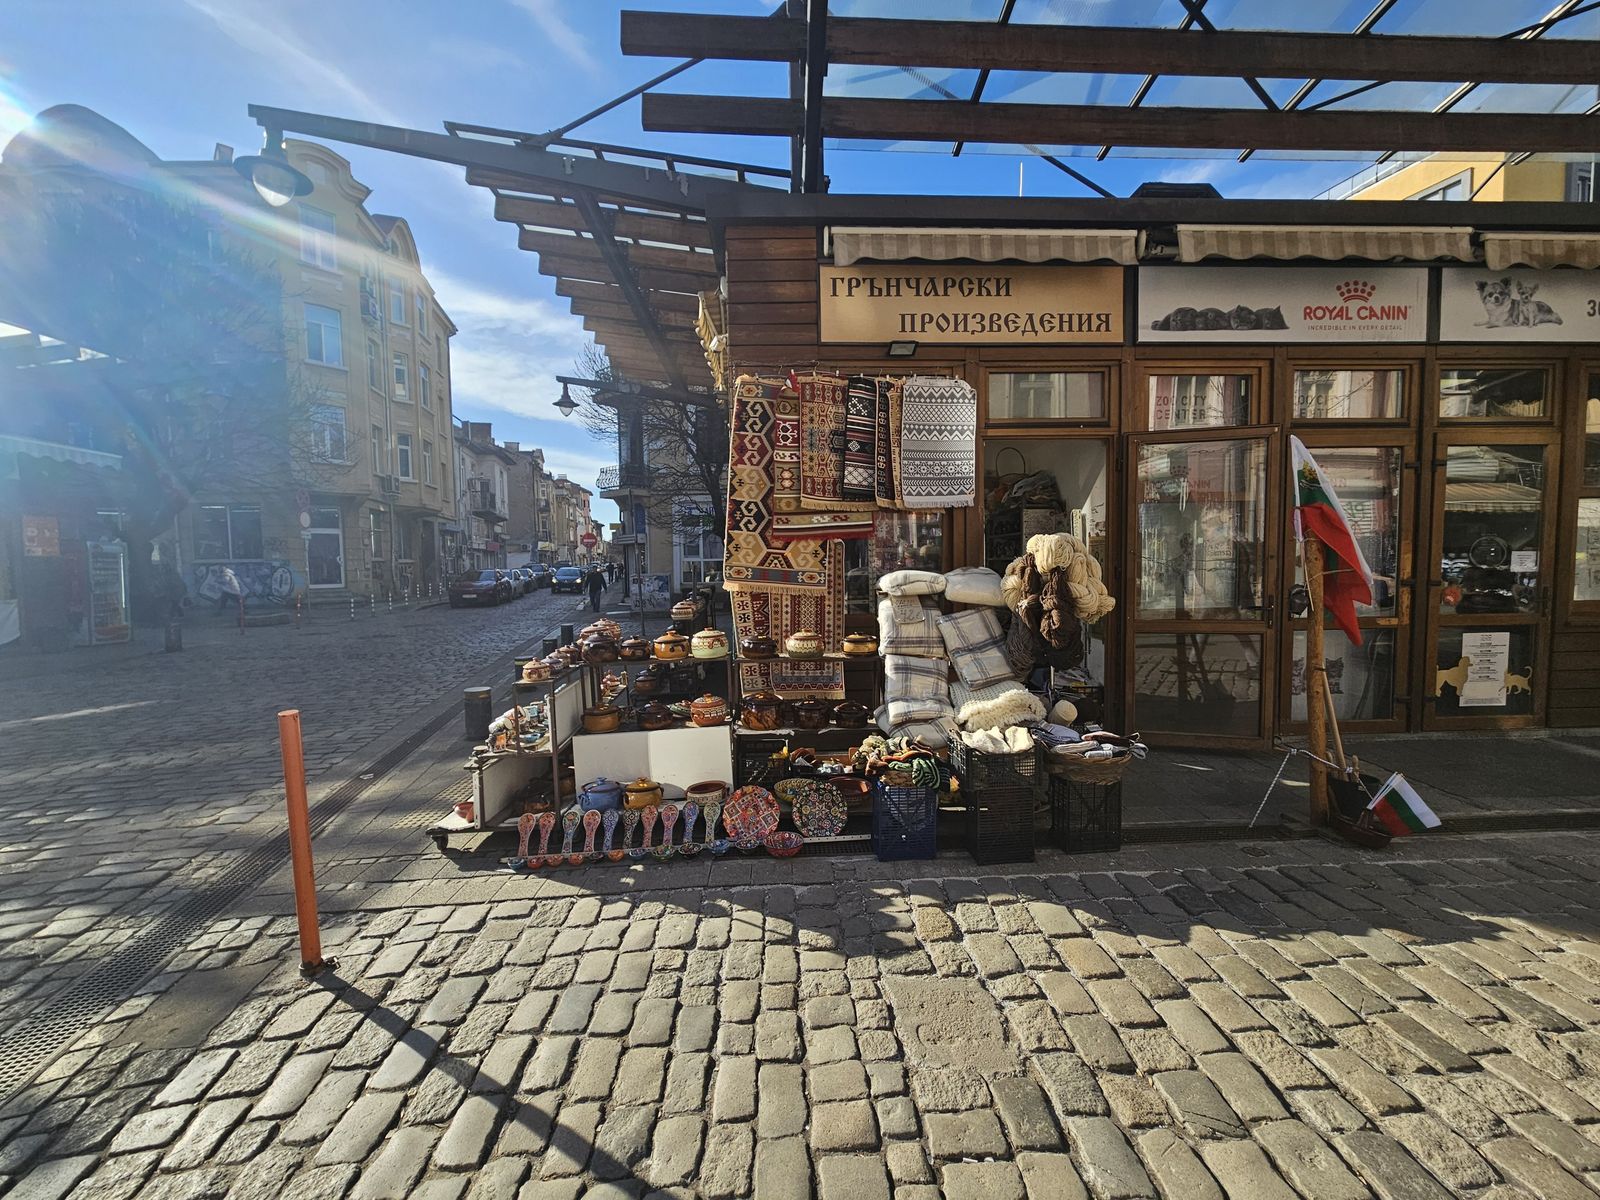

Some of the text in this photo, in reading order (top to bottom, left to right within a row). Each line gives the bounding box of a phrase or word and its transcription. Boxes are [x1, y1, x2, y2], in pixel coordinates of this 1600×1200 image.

[830, 277, 1012, 297] ГРЪНЧАРСКИ
[1303, 305, 1408, 321] ROYAL CANIN
[898, 312, 1112, 337] ПРОИЗВЕДЕНИЯ
